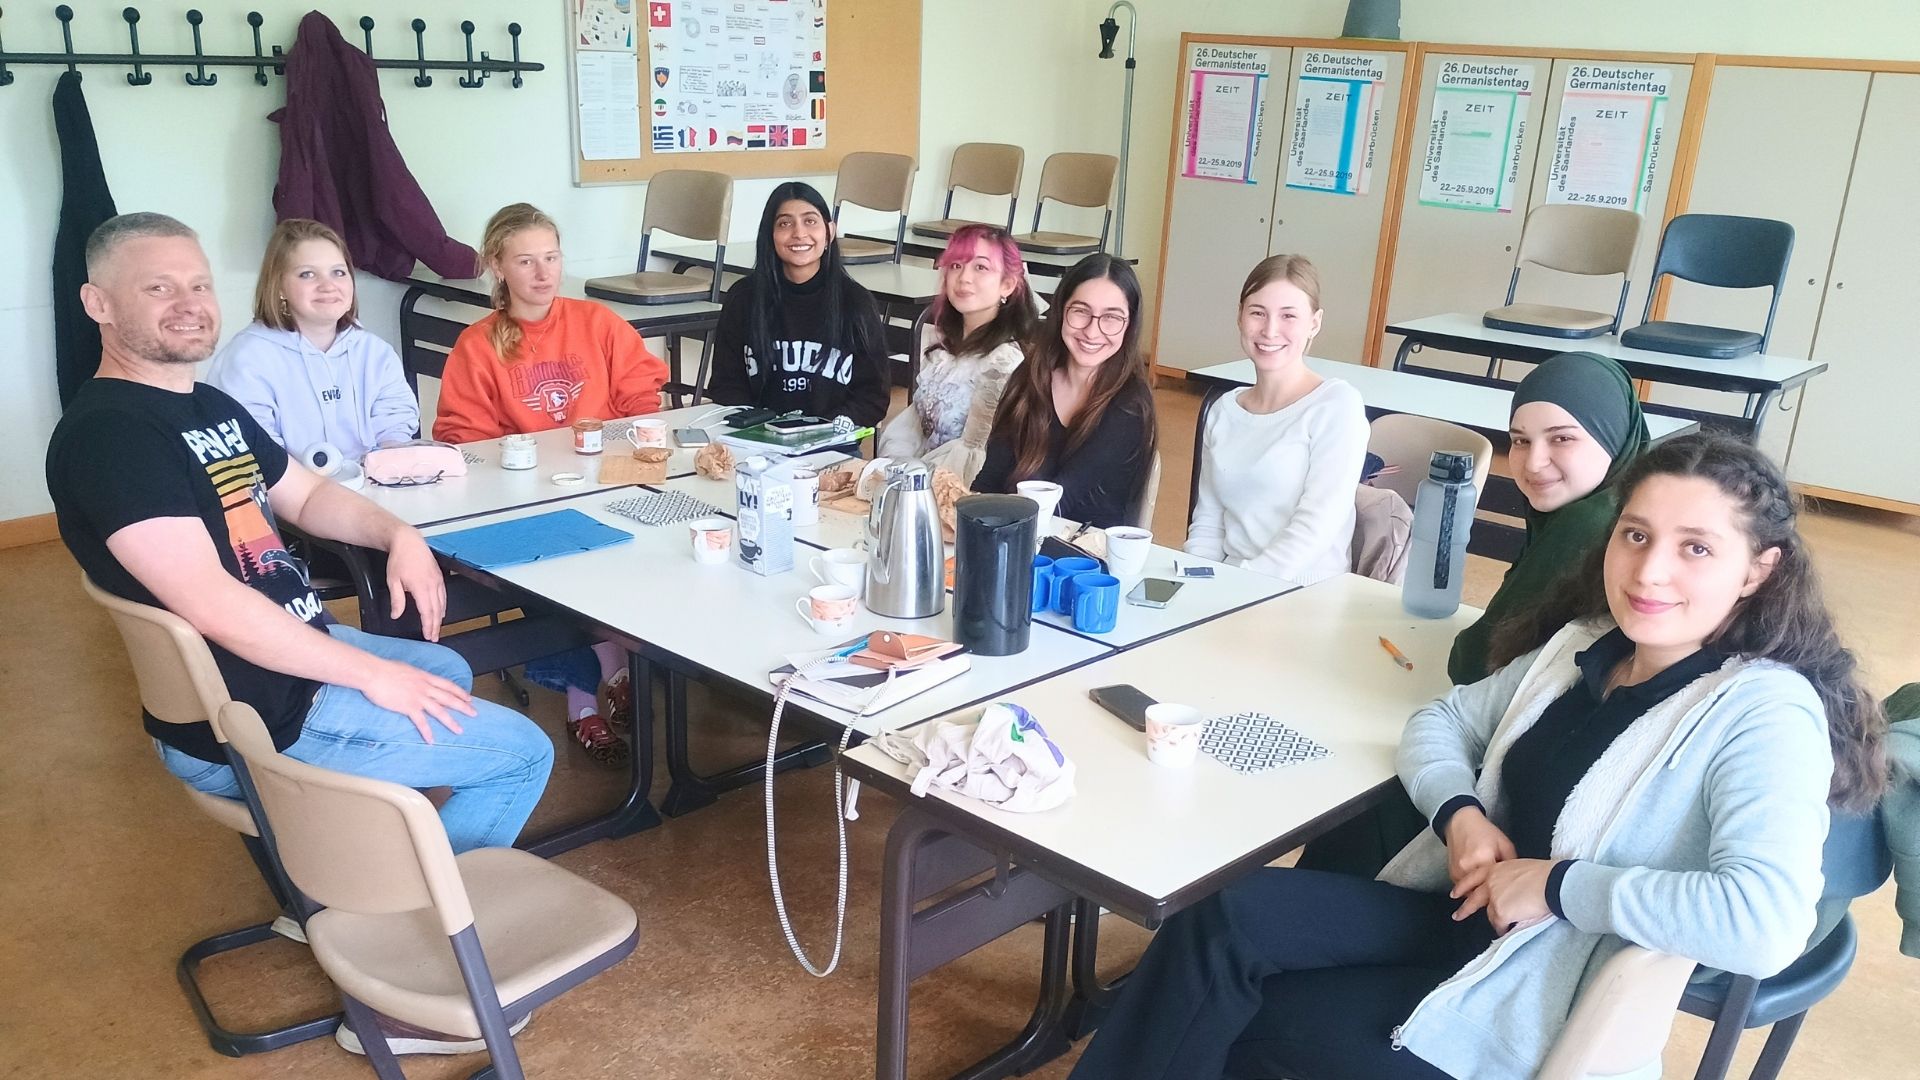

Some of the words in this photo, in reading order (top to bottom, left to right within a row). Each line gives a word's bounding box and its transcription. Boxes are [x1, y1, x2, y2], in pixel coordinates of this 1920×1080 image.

[1196, 48, 1210, 58] 26.
[1211, 49, 1258, 60] Deutscher
[1306, 53, 1321, 64] 26.
[1322, 54, 1373, 66] Deutscher
[1195, 59, 1266, 73] Germanistentag
[1304, 64, 1383, 80] Germanistentag
[1444, 62, 1460, 73] 26.
[1462, 63, 1519, 76] Deutscher
[1572, 67, 1590, 78] 26.
[1592, 67, 1655, 81] Deutscher
[1216, 85, 1240, 94] ZEIT
[1442, 74, 1529, 91] Germanistentag
[1570, 79, 1666, 95] Germanistentag
[1326, 92, 1352, 102] ZEIT
[1465, 104, 1495, 113] ZEIT
[1595, 109, 1628, 119] ZEIT
[1290, 107, 1302, 156] Universität
[1299, 98, 1311, 148] Saarlandes
[1366, 109, 1381, 169] Saarbrücken
[1425, 119, 1439, 172] Universität
[1434, 110, 1448, 164] Saarlandes
[1561, 116, 1577, 172] Saarlandes
[1509, 121, 1526, 184] Saarbrücken
[1550, 126, 1567, 181] Universität
[1643, 127, 1662, 193] Saarbrücken
[1431, 165, 1440, 183] des
[1557, 174, 1567, 192] des
[739, 490, 758, 510] LY!
